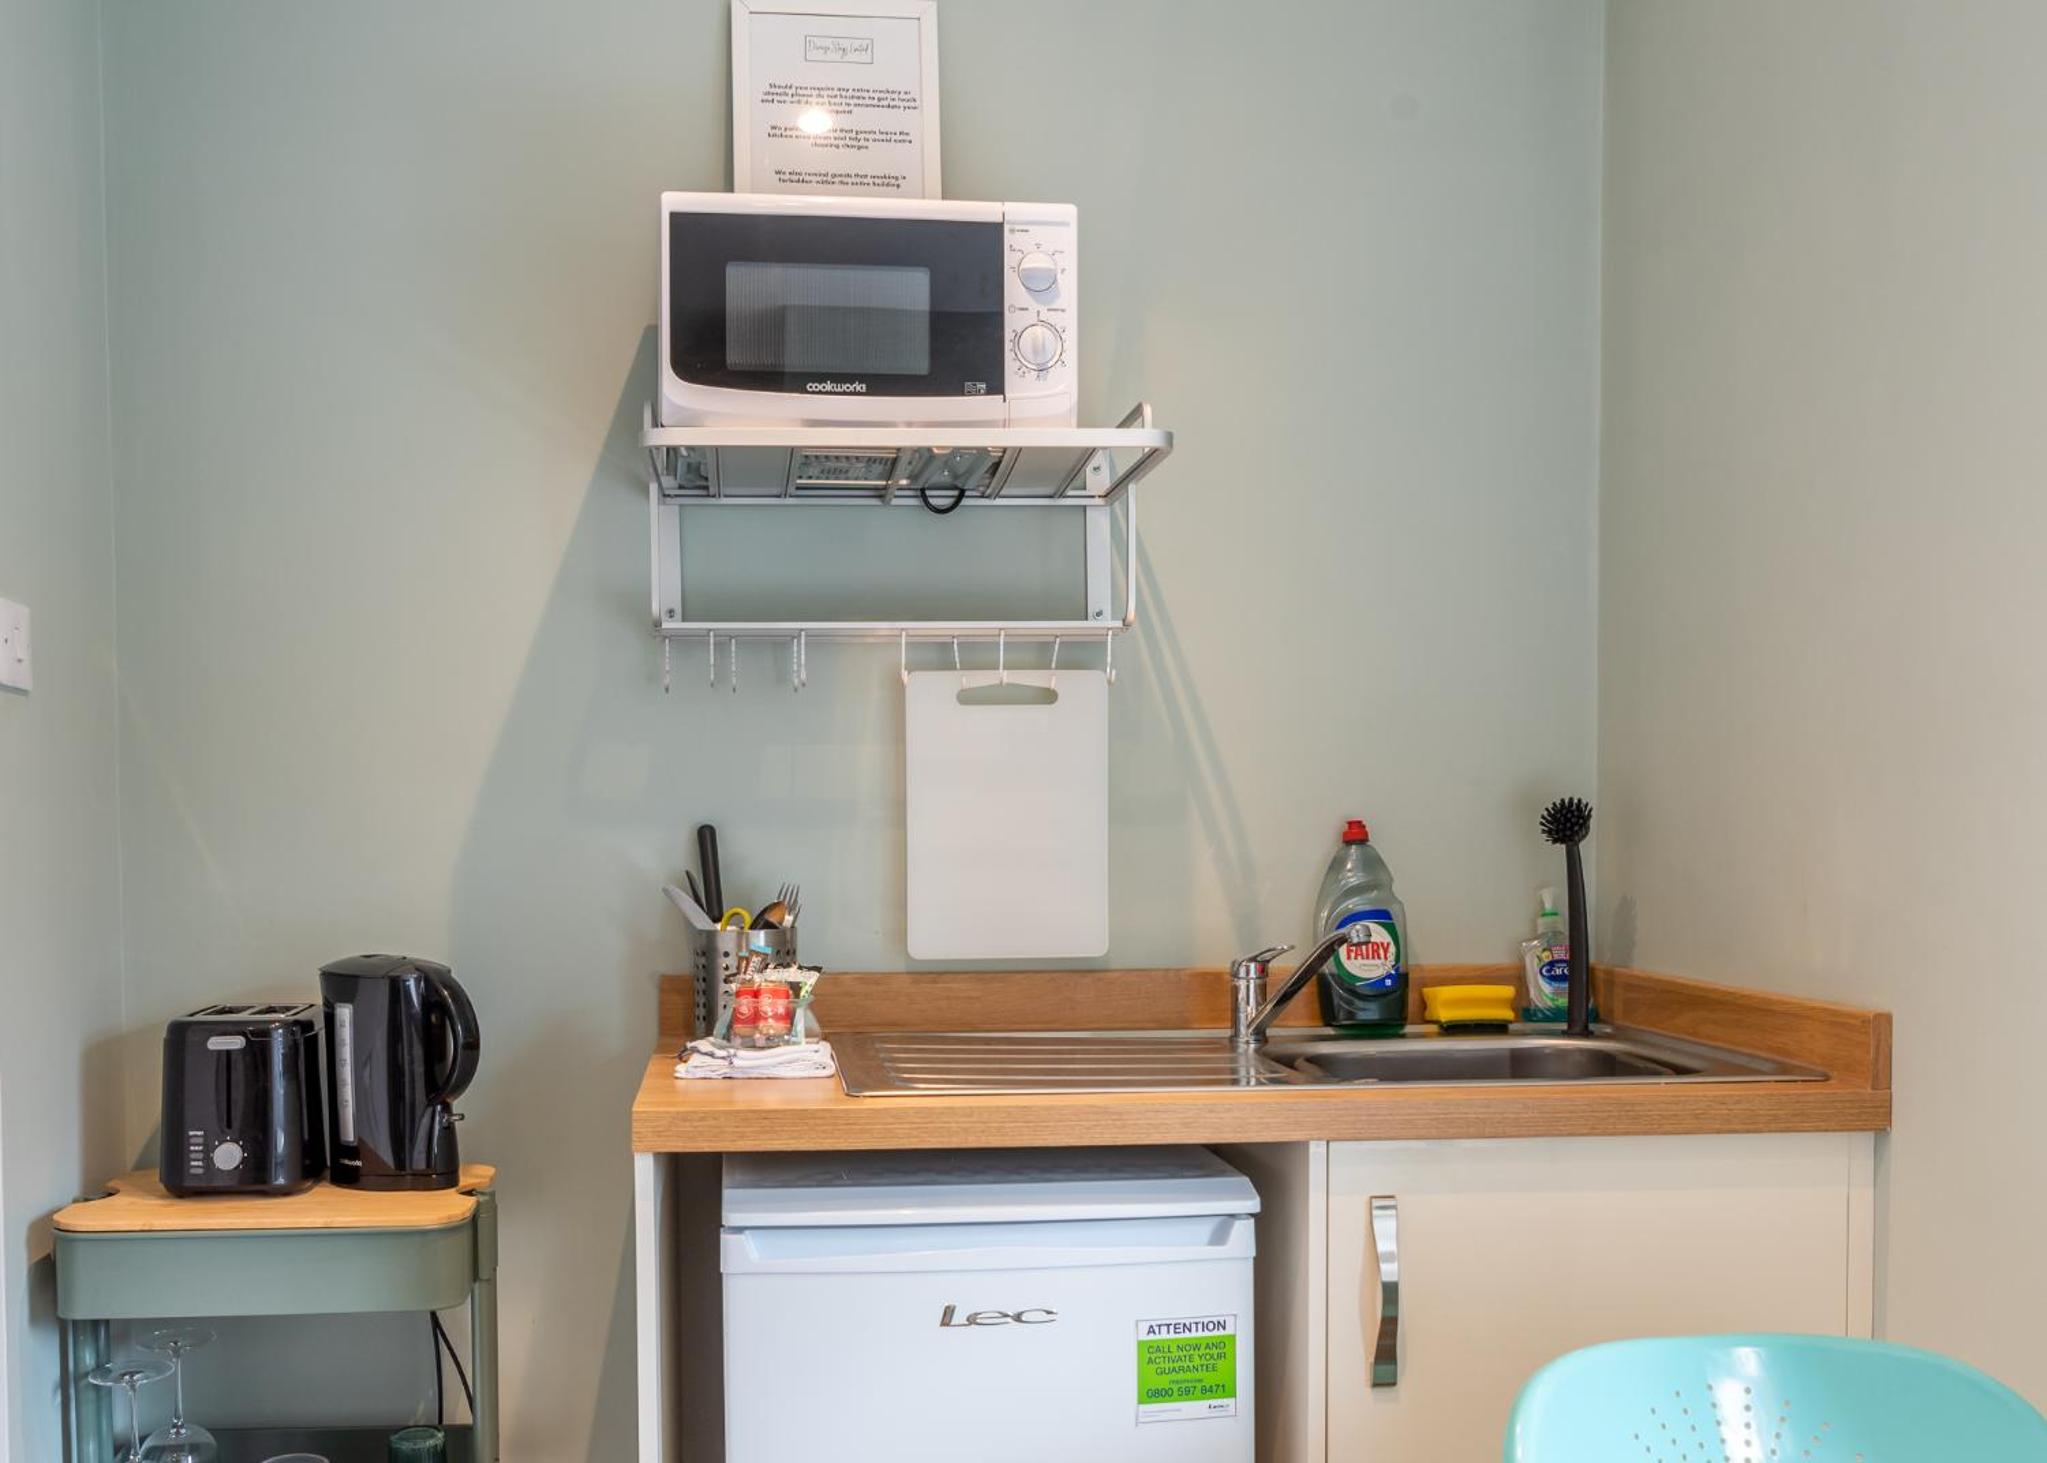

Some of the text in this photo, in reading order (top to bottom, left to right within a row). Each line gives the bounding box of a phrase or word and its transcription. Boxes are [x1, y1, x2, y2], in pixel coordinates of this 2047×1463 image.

[769, 82, 793, 90] Should
[1345, 941, 1391, 960] FAIRY
[940, 1304, 1058, 1327] Lec
[1147, 1319, 1227, 1336] ATTENTION
[1147, 1341, 1226, 1354] CALL NOW AND
[1147, 1352, 1226, 1365] ACTIVATE YOUR
[1155, 1363, 1218, 1376] GUARANTEE
[1146, 1387, 1174, 1399] 0800
